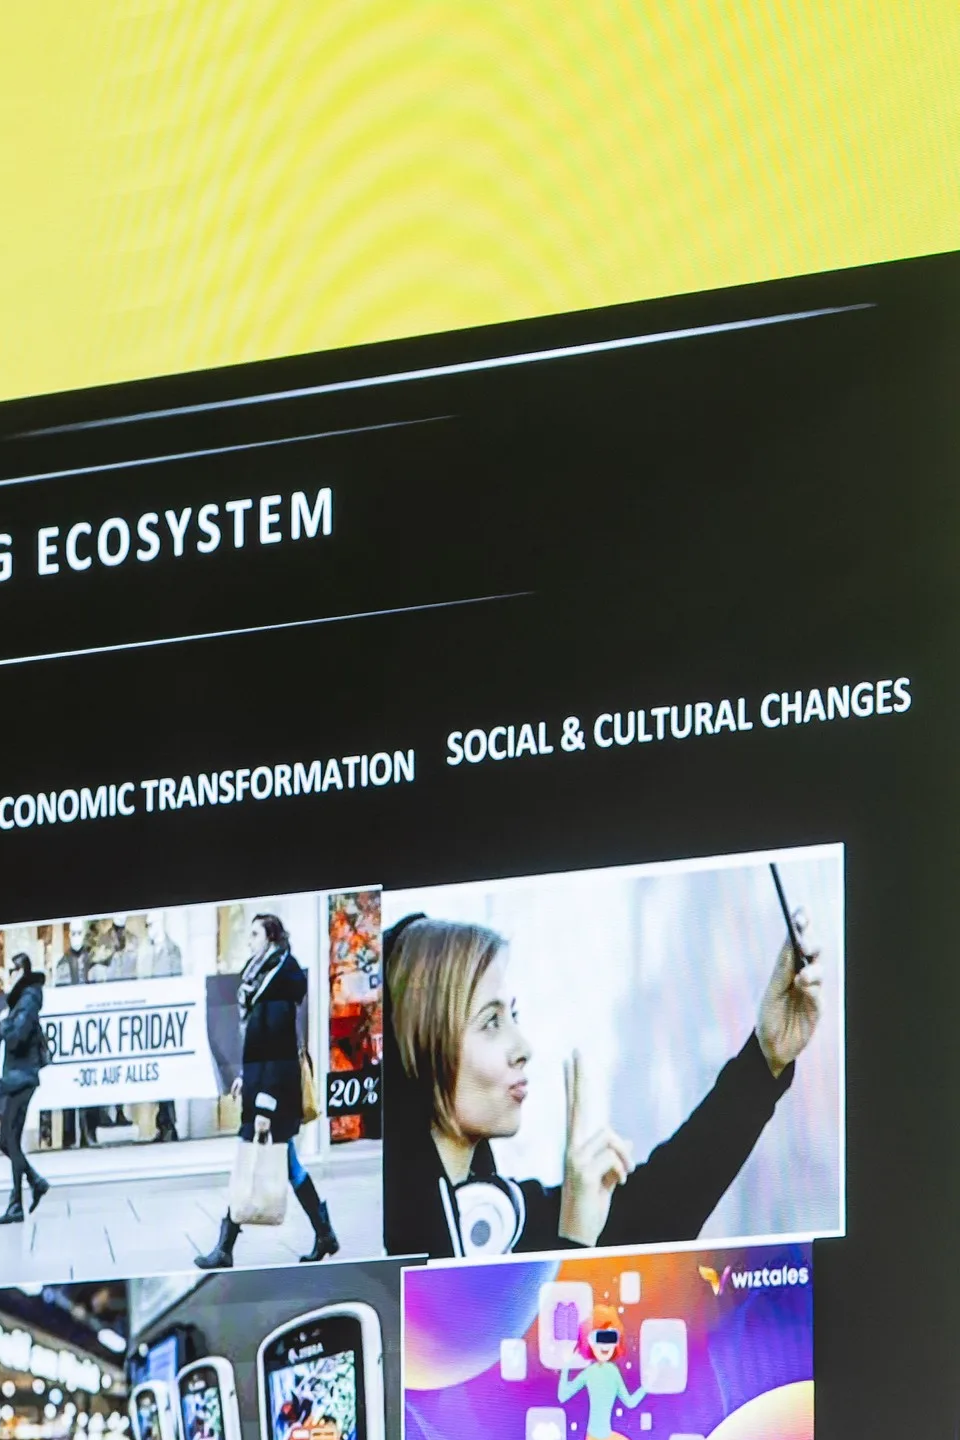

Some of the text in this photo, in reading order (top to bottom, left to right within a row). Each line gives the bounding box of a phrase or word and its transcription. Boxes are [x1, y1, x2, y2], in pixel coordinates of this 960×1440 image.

[37, 487, 333, 576] ECOSYSTEM
[446, 676, 912, 766] SOCIAL & CULTURAL CHANGES
[140, 748, 415, 813] TRANSFORMATION
[46, 1011, 188, 1057] BLACK FRIDAY
[102, 1064, 122, 1085] AUF
[125, 1062, 159, 1084] ALLES
[328, 1077, 379, 1107] 20%
[731, 1265, 809, 1289] wiztales
